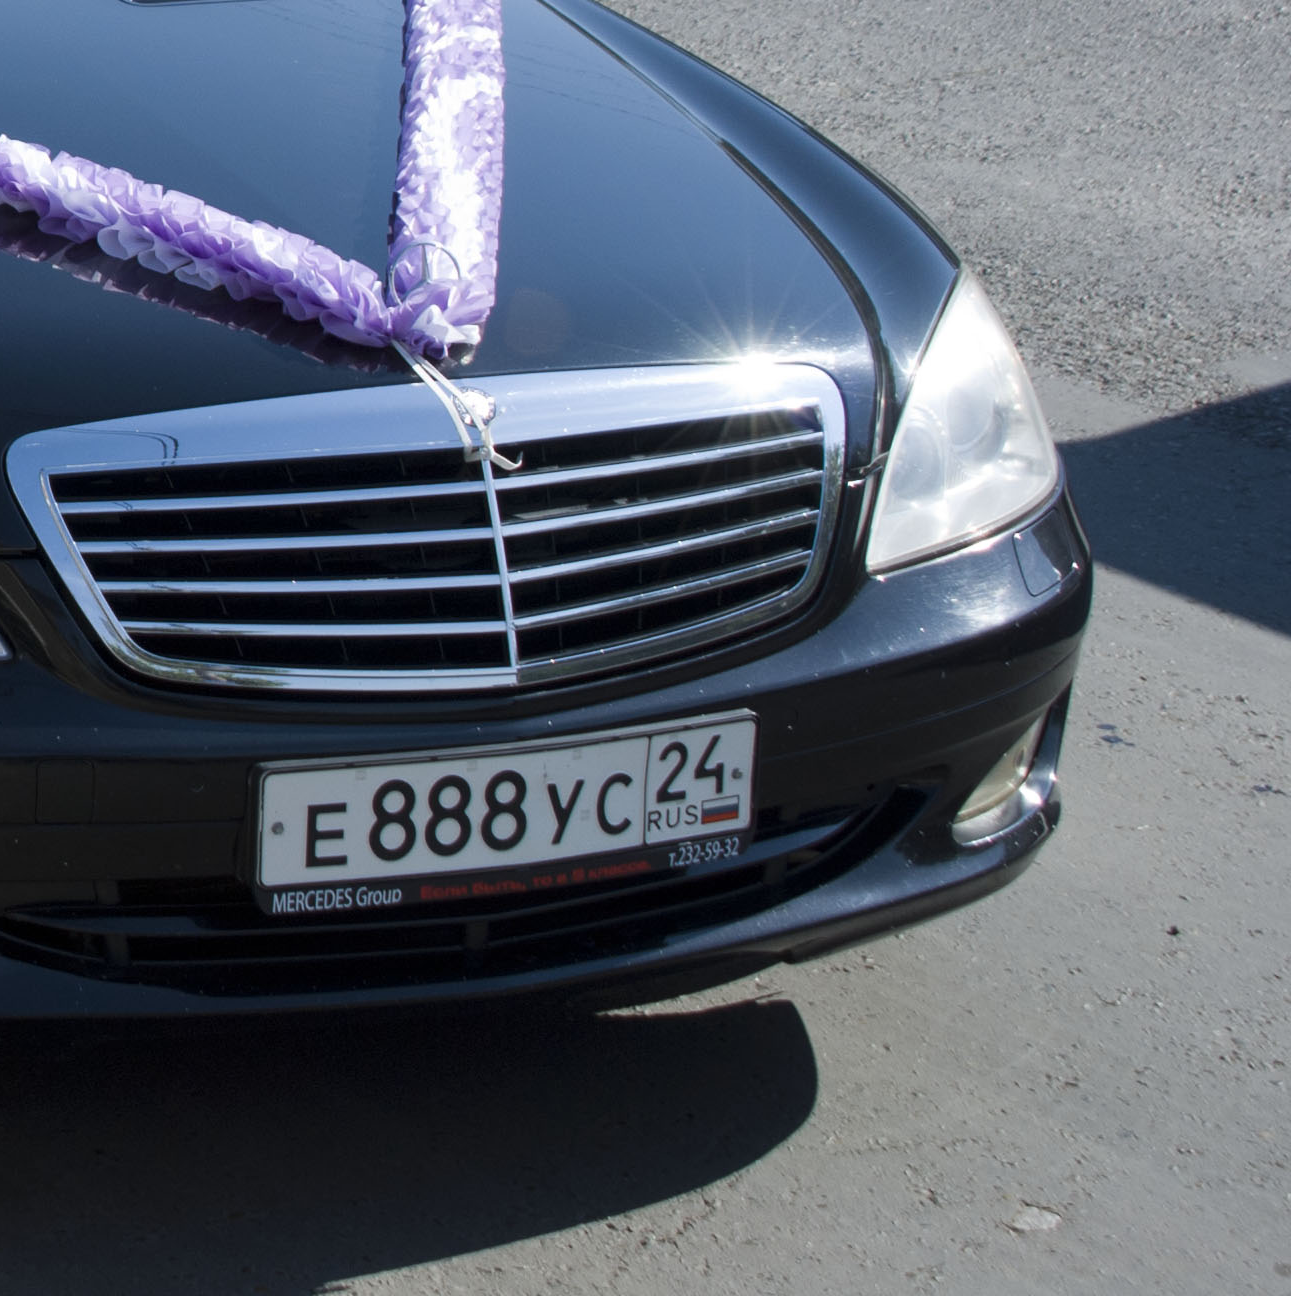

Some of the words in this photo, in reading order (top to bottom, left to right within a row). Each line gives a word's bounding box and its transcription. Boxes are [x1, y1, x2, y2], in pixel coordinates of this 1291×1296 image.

[656, 734, 725, 804] 24
[647, 804, 699, 833] RUS
[272, 887, 353, 914] MERCEDES
[356, 886, 402, 908] Group
